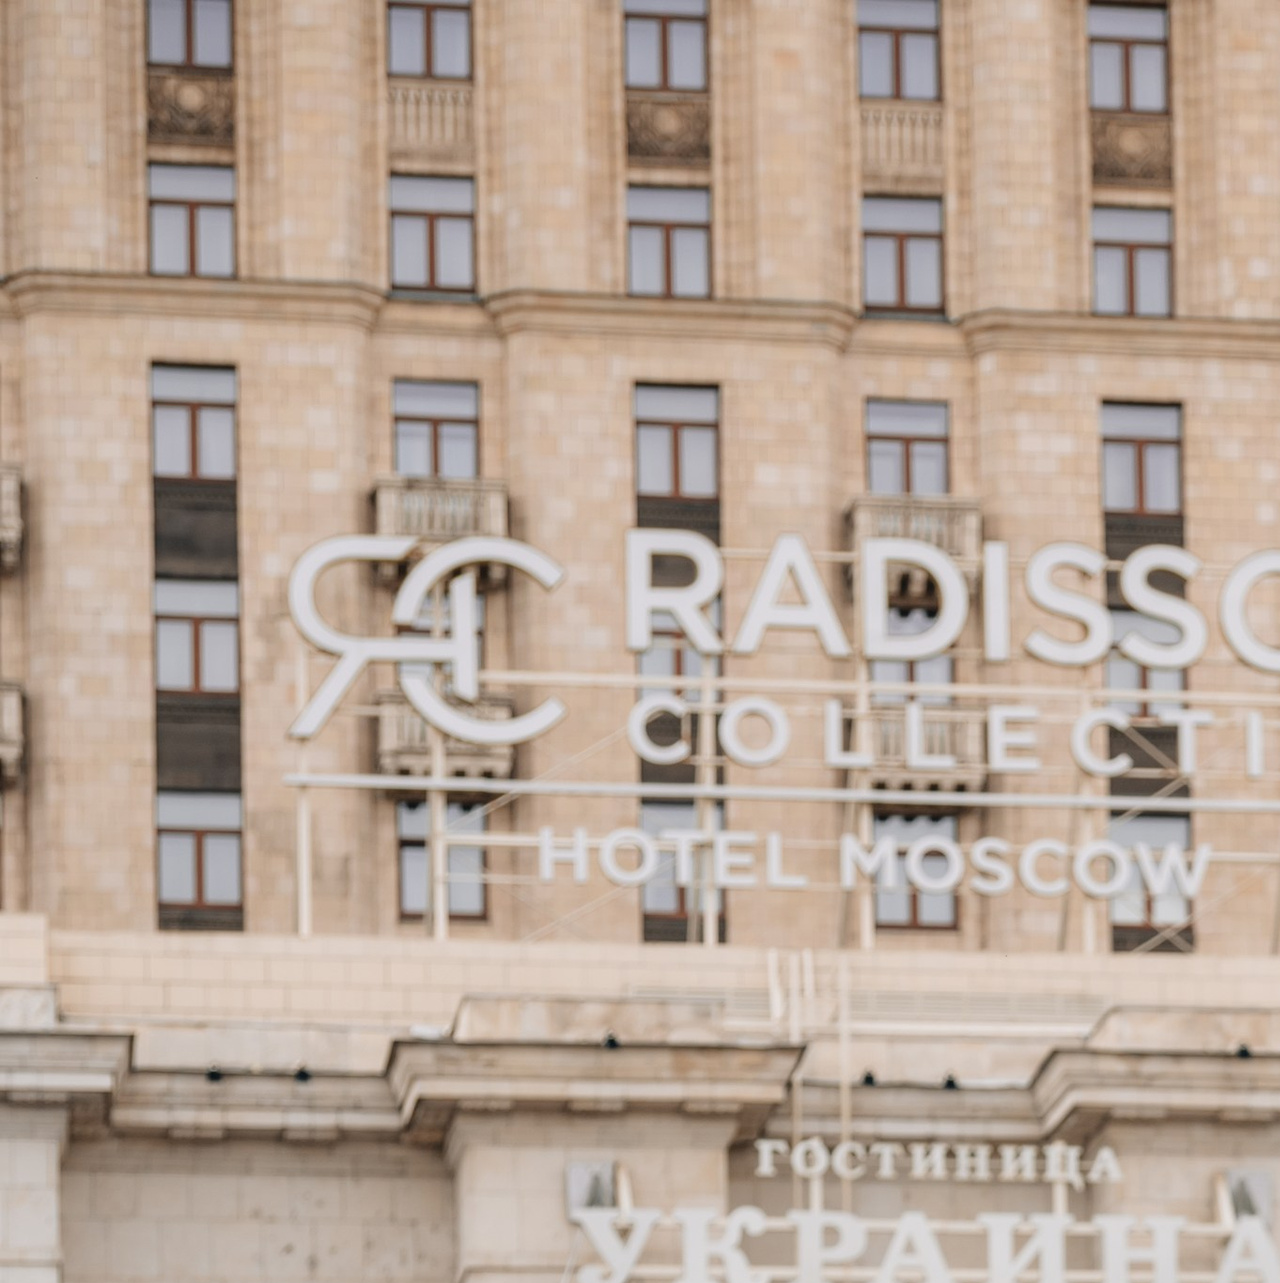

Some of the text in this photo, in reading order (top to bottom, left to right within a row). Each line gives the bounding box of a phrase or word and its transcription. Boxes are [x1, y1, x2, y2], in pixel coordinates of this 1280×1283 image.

[538, 825, 1213, 899] HOTEL MOSCOW
[754, 1136, 1123, 1192] ГОСТИНИЦА
